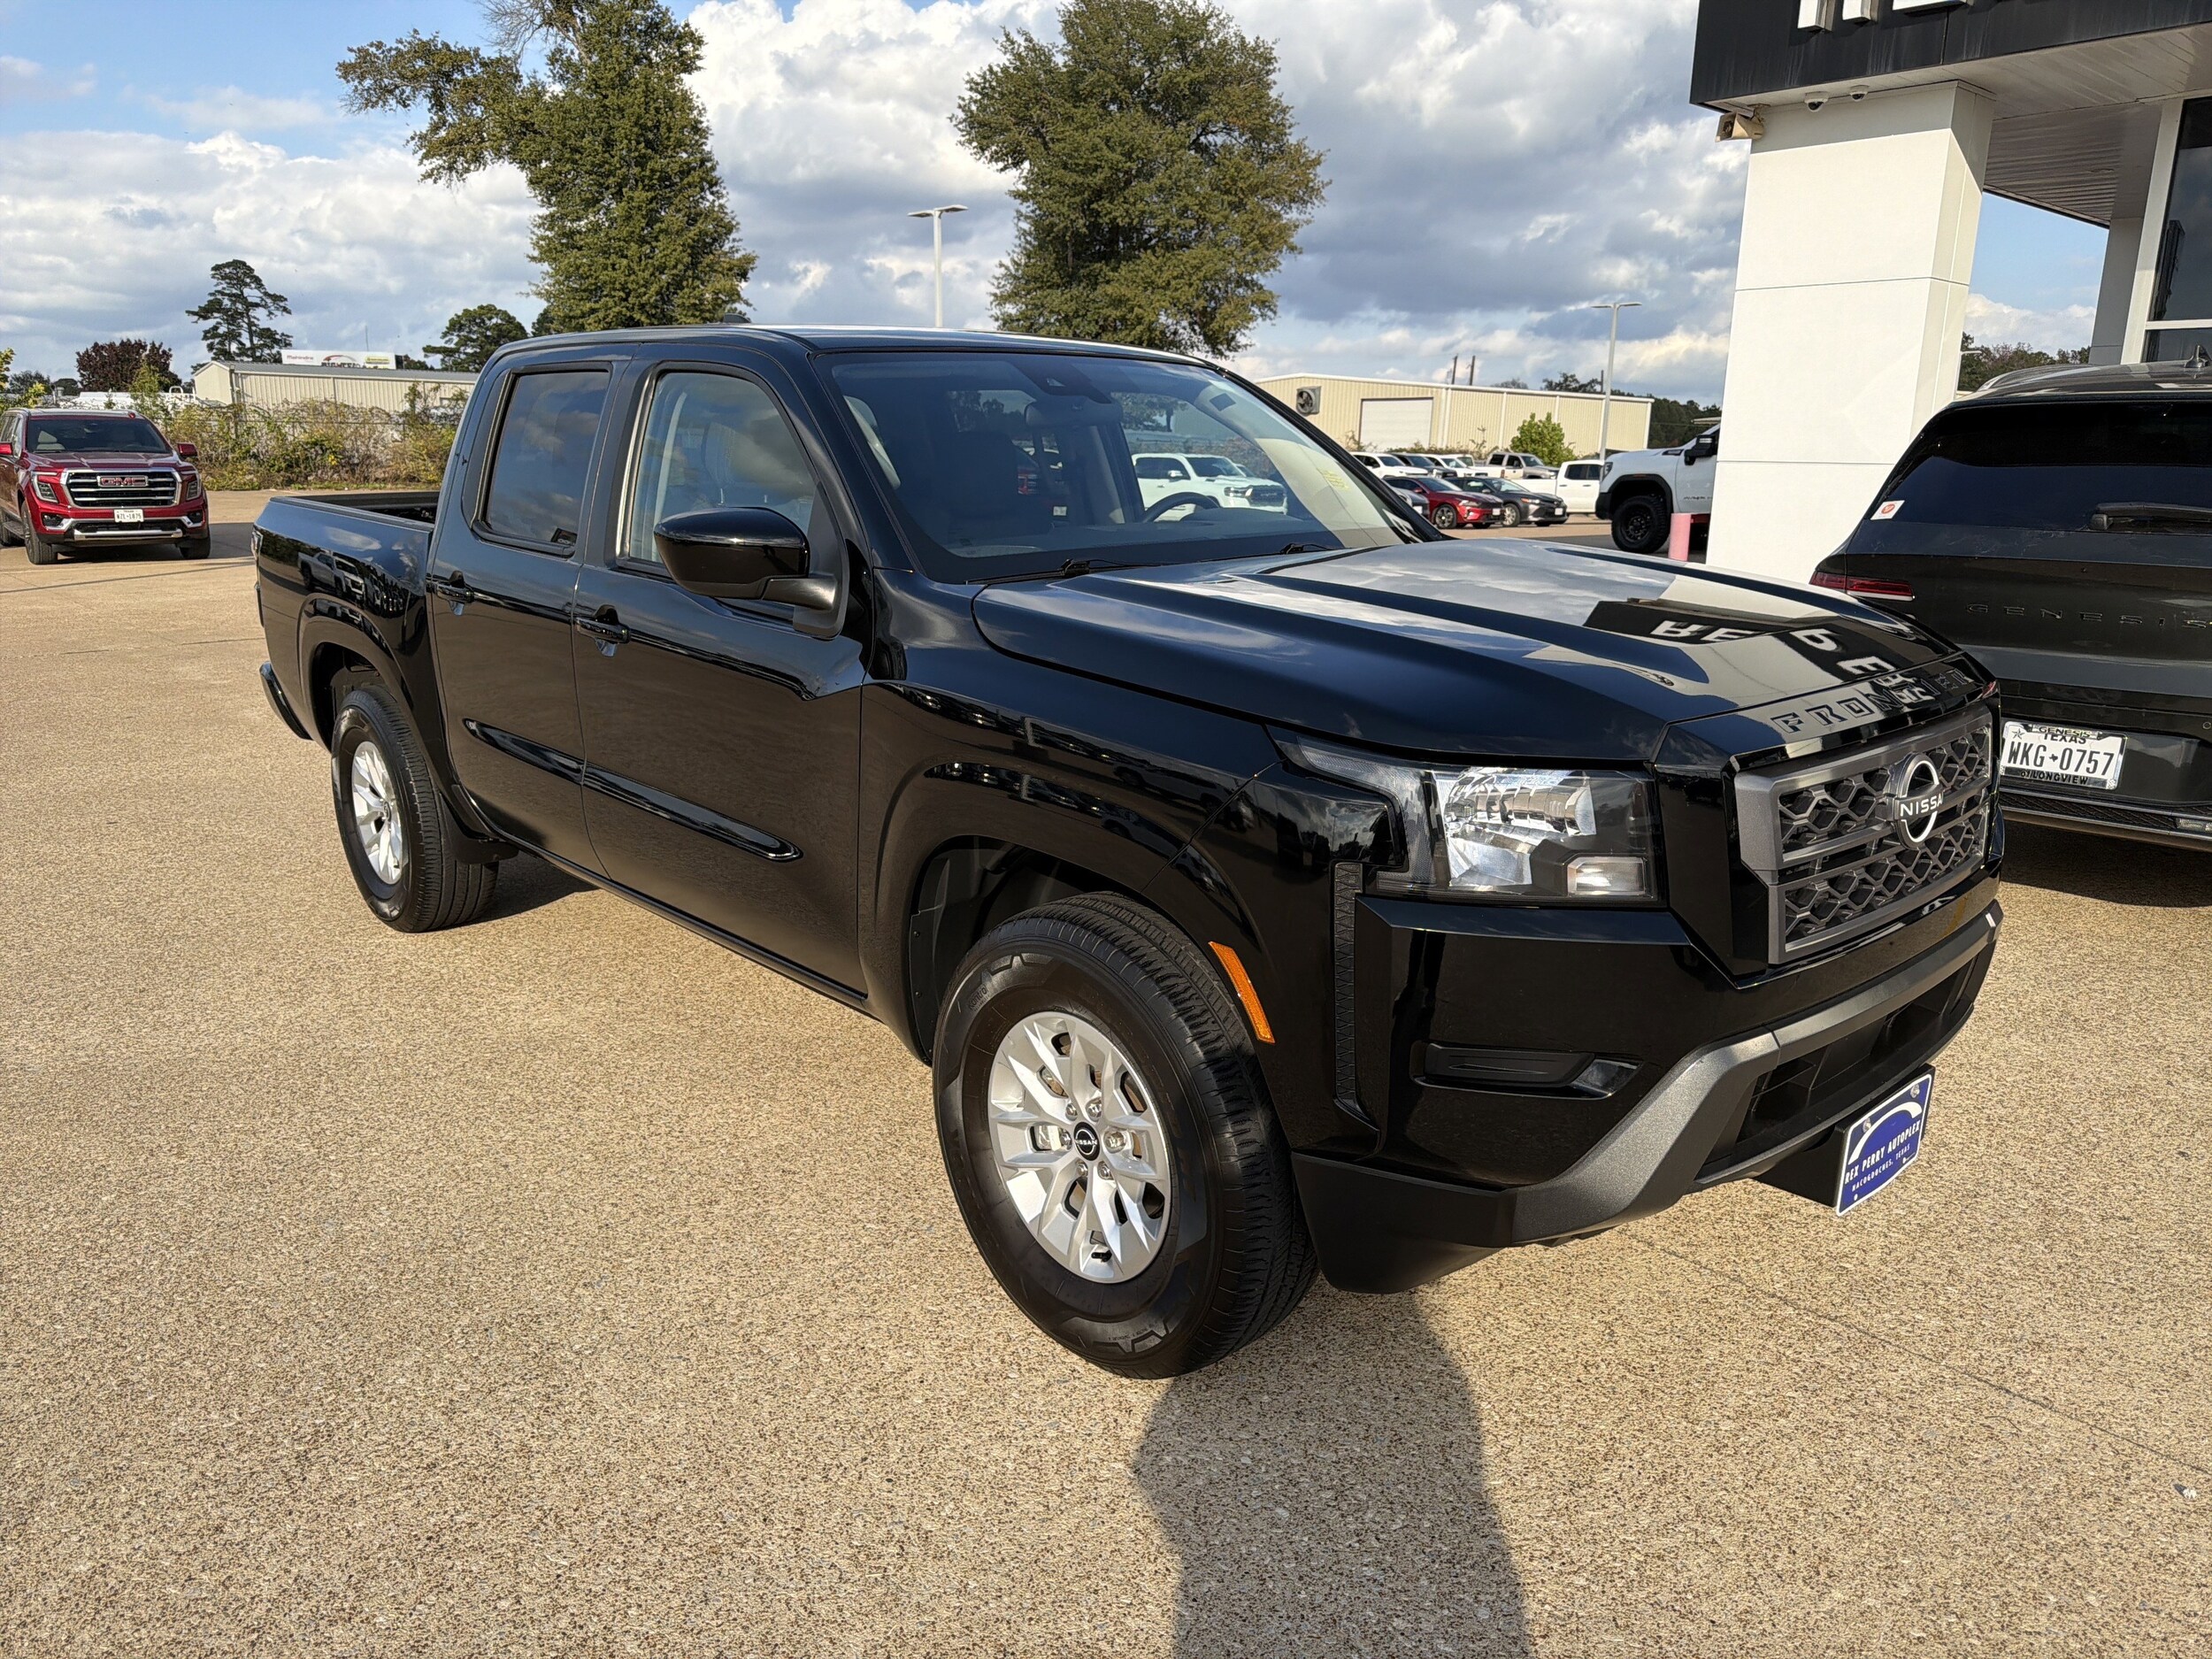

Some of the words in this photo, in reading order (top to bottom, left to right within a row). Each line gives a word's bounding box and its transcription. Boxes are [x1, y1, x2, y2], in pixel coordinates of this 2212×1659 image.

[101, 477, 146, 486] GMC
[1966, 603, 2207, 629] GENESIS
[1770, 668, 1975, 733] FRONTIER
[2039, 726, 2092, 738] GENESIS
[2043, 733, 2087, 745] TEXAS
[2032, 772, 2089, 786] LONGVIEW
[1900, 792, 1944, 817] NISSA
[1845, 1164, 1860, 1185] REX
[1862, 1146, 1886, 1172] PERRY
[1887, 1120, 1921, 1154] AUTOPLEX
[1895, 1143, 1911, 1161] TEXAS
